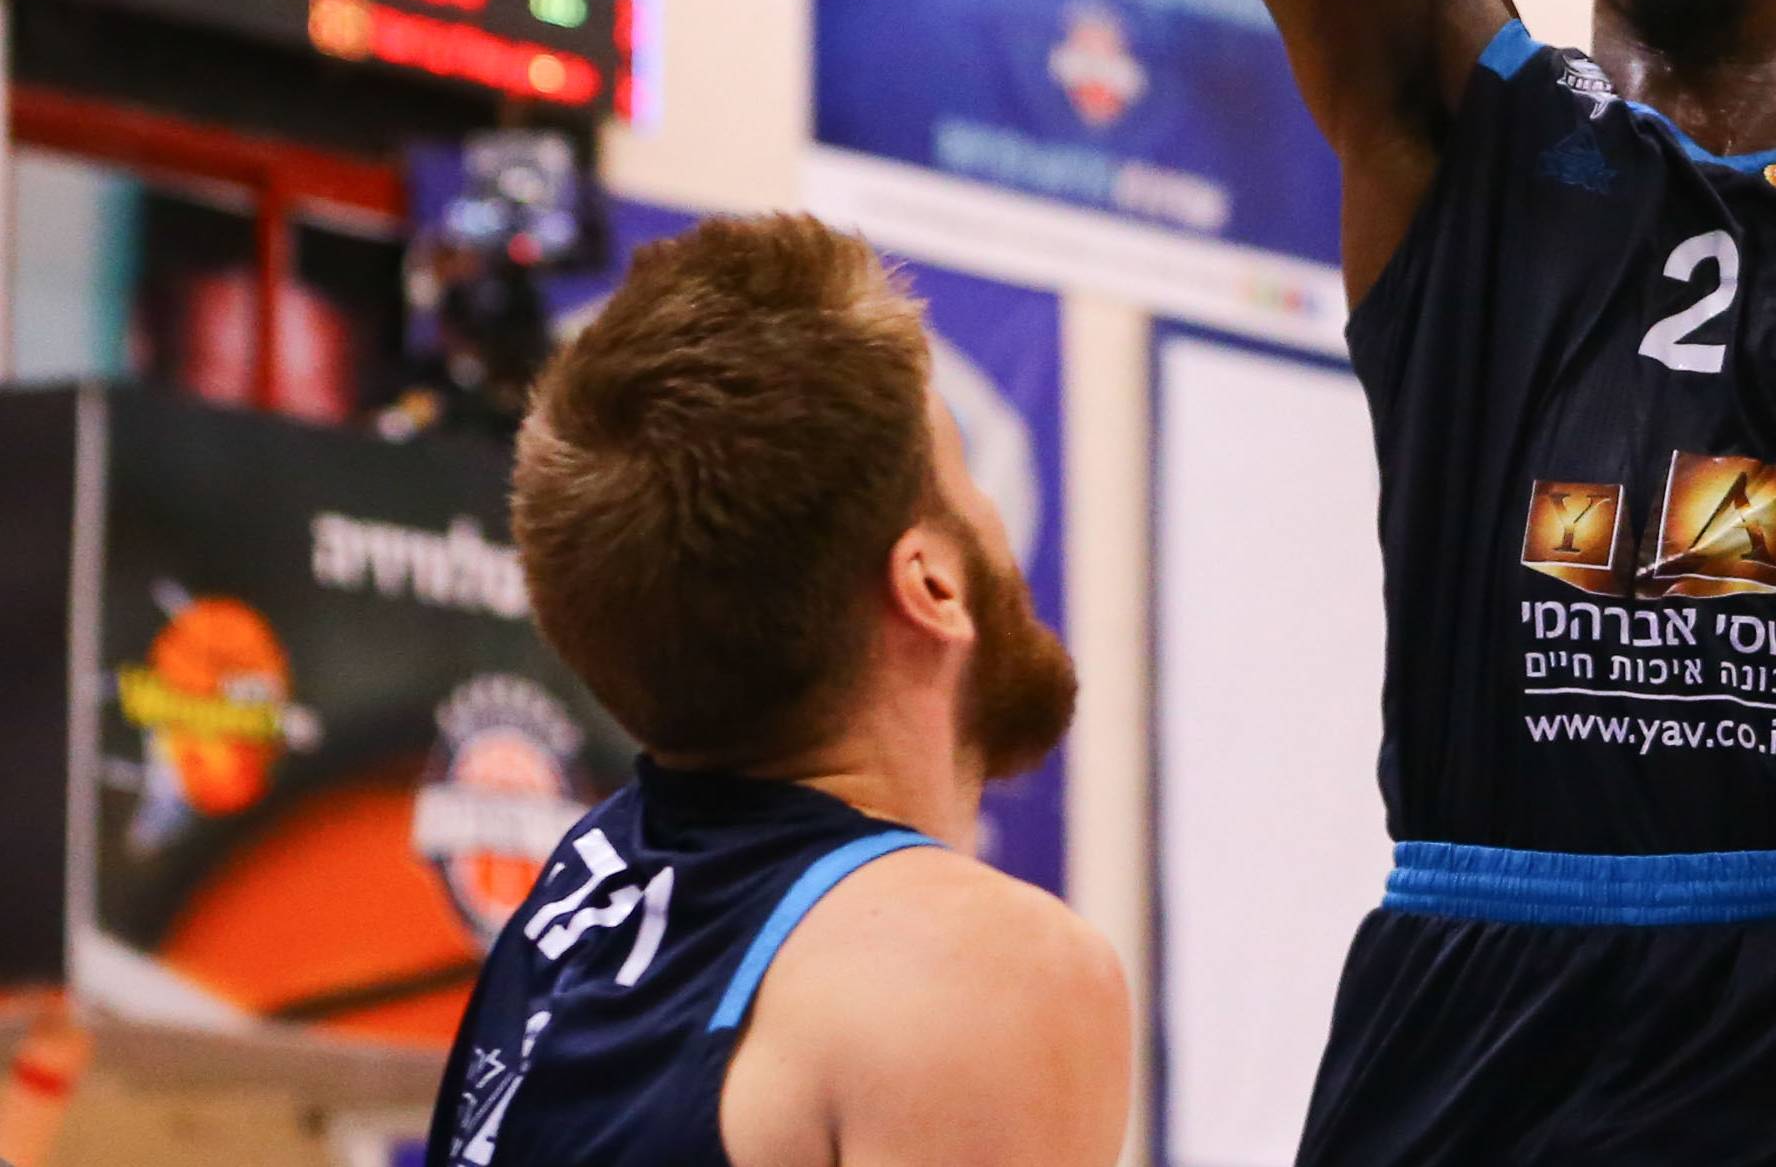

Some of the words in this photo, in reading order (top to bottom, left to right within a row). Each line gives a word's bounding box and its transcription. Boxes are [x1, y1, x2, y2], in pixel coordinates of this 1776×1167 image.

[1638, 230, 1739, 373] 2
[1521, 601, 1698, 647] אברהמי
[1524, 651, 1594, 679] חיים
[1609, 655, 1703, 685] איכות
